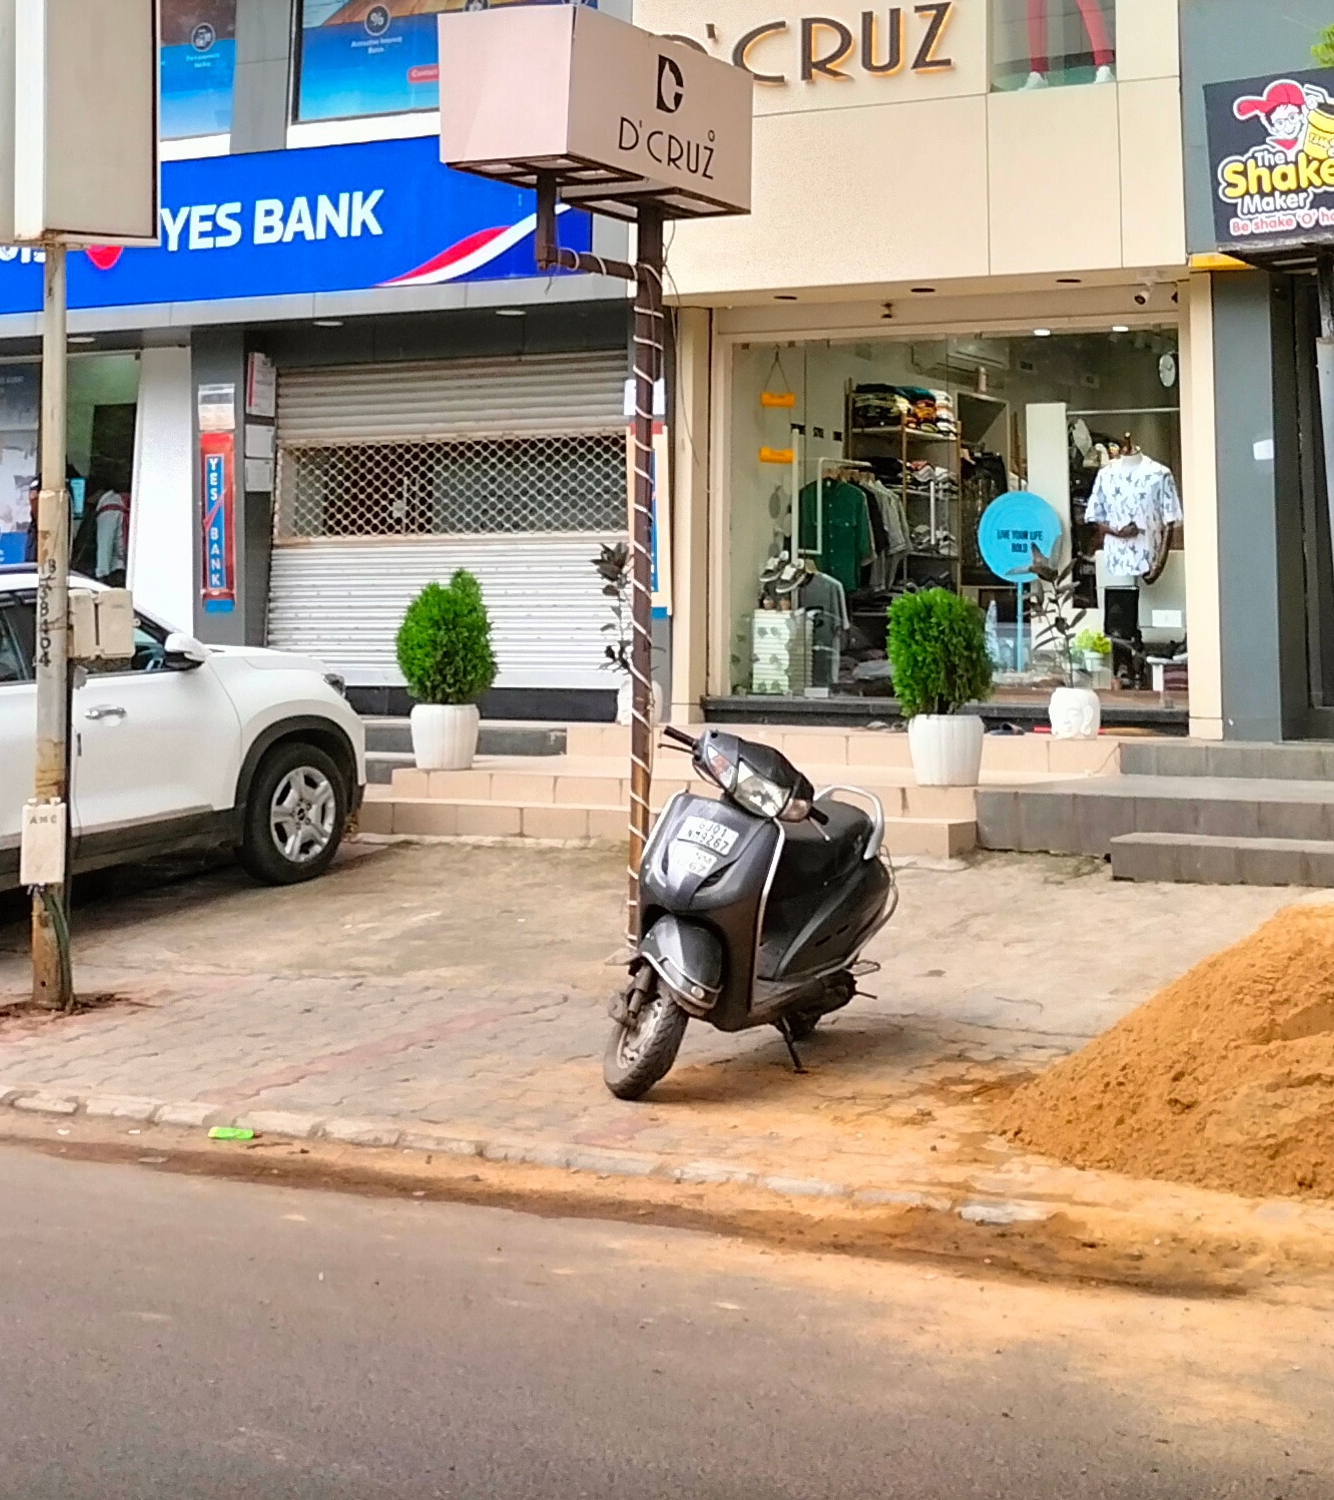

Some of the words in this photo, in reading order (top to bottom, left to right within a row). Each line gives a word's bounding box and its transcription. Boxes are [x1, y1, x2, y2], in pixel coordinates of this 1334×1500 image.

[618, 116, 715, 180] D'CRUZ
[1254, 151, 1286, 166] The
[160, 200, 242, 253] YES
[253, 188, 385, 245] BANK
[1232, 221, 1249, 233] Be
[1253, 216, 1295, 232] shake
[1242, 191, 1308, 215] Maker
[208, 457, 220, 502] YES
[209, 526, 222, 587] BANK
